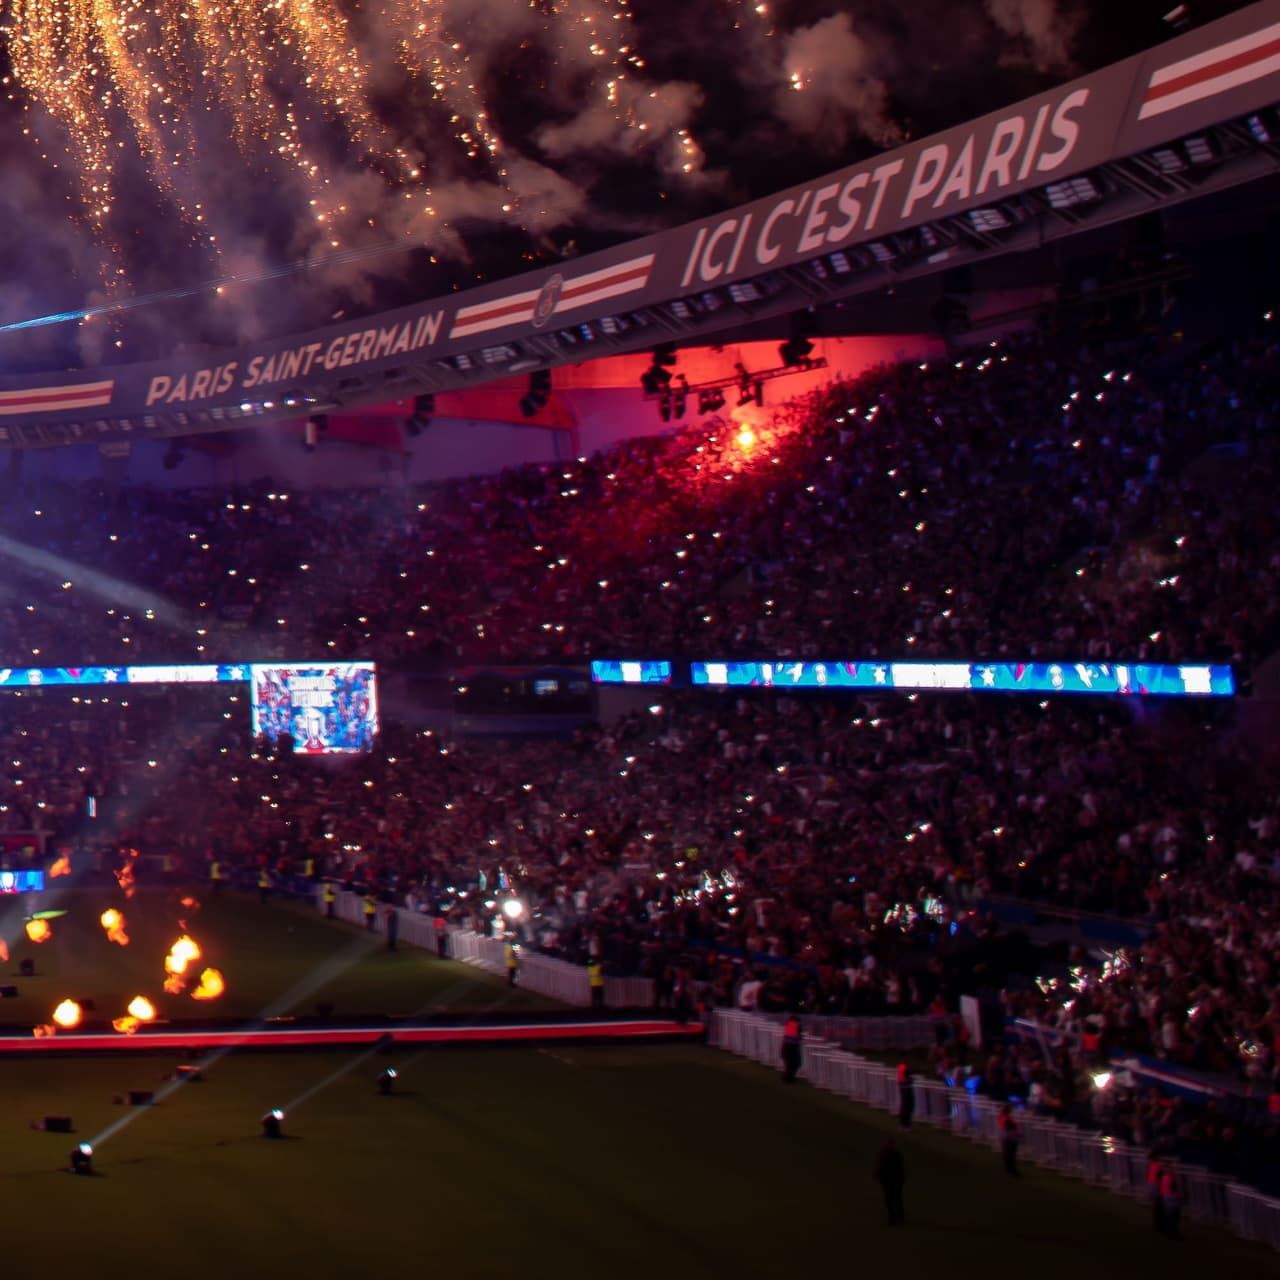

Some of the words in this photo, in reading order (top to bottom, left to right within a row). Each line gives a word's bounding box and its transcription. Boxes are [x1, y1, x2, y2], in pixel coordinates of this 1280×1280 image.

[680, 212, 753, 288] ICI
[755, 158, 905, 265] C'EST
[901, 87, 1091, 218] PARIS
[144, 361, 239, 407] PARIS
[241, 309, 445, 389] SAINT-GERMAIN
